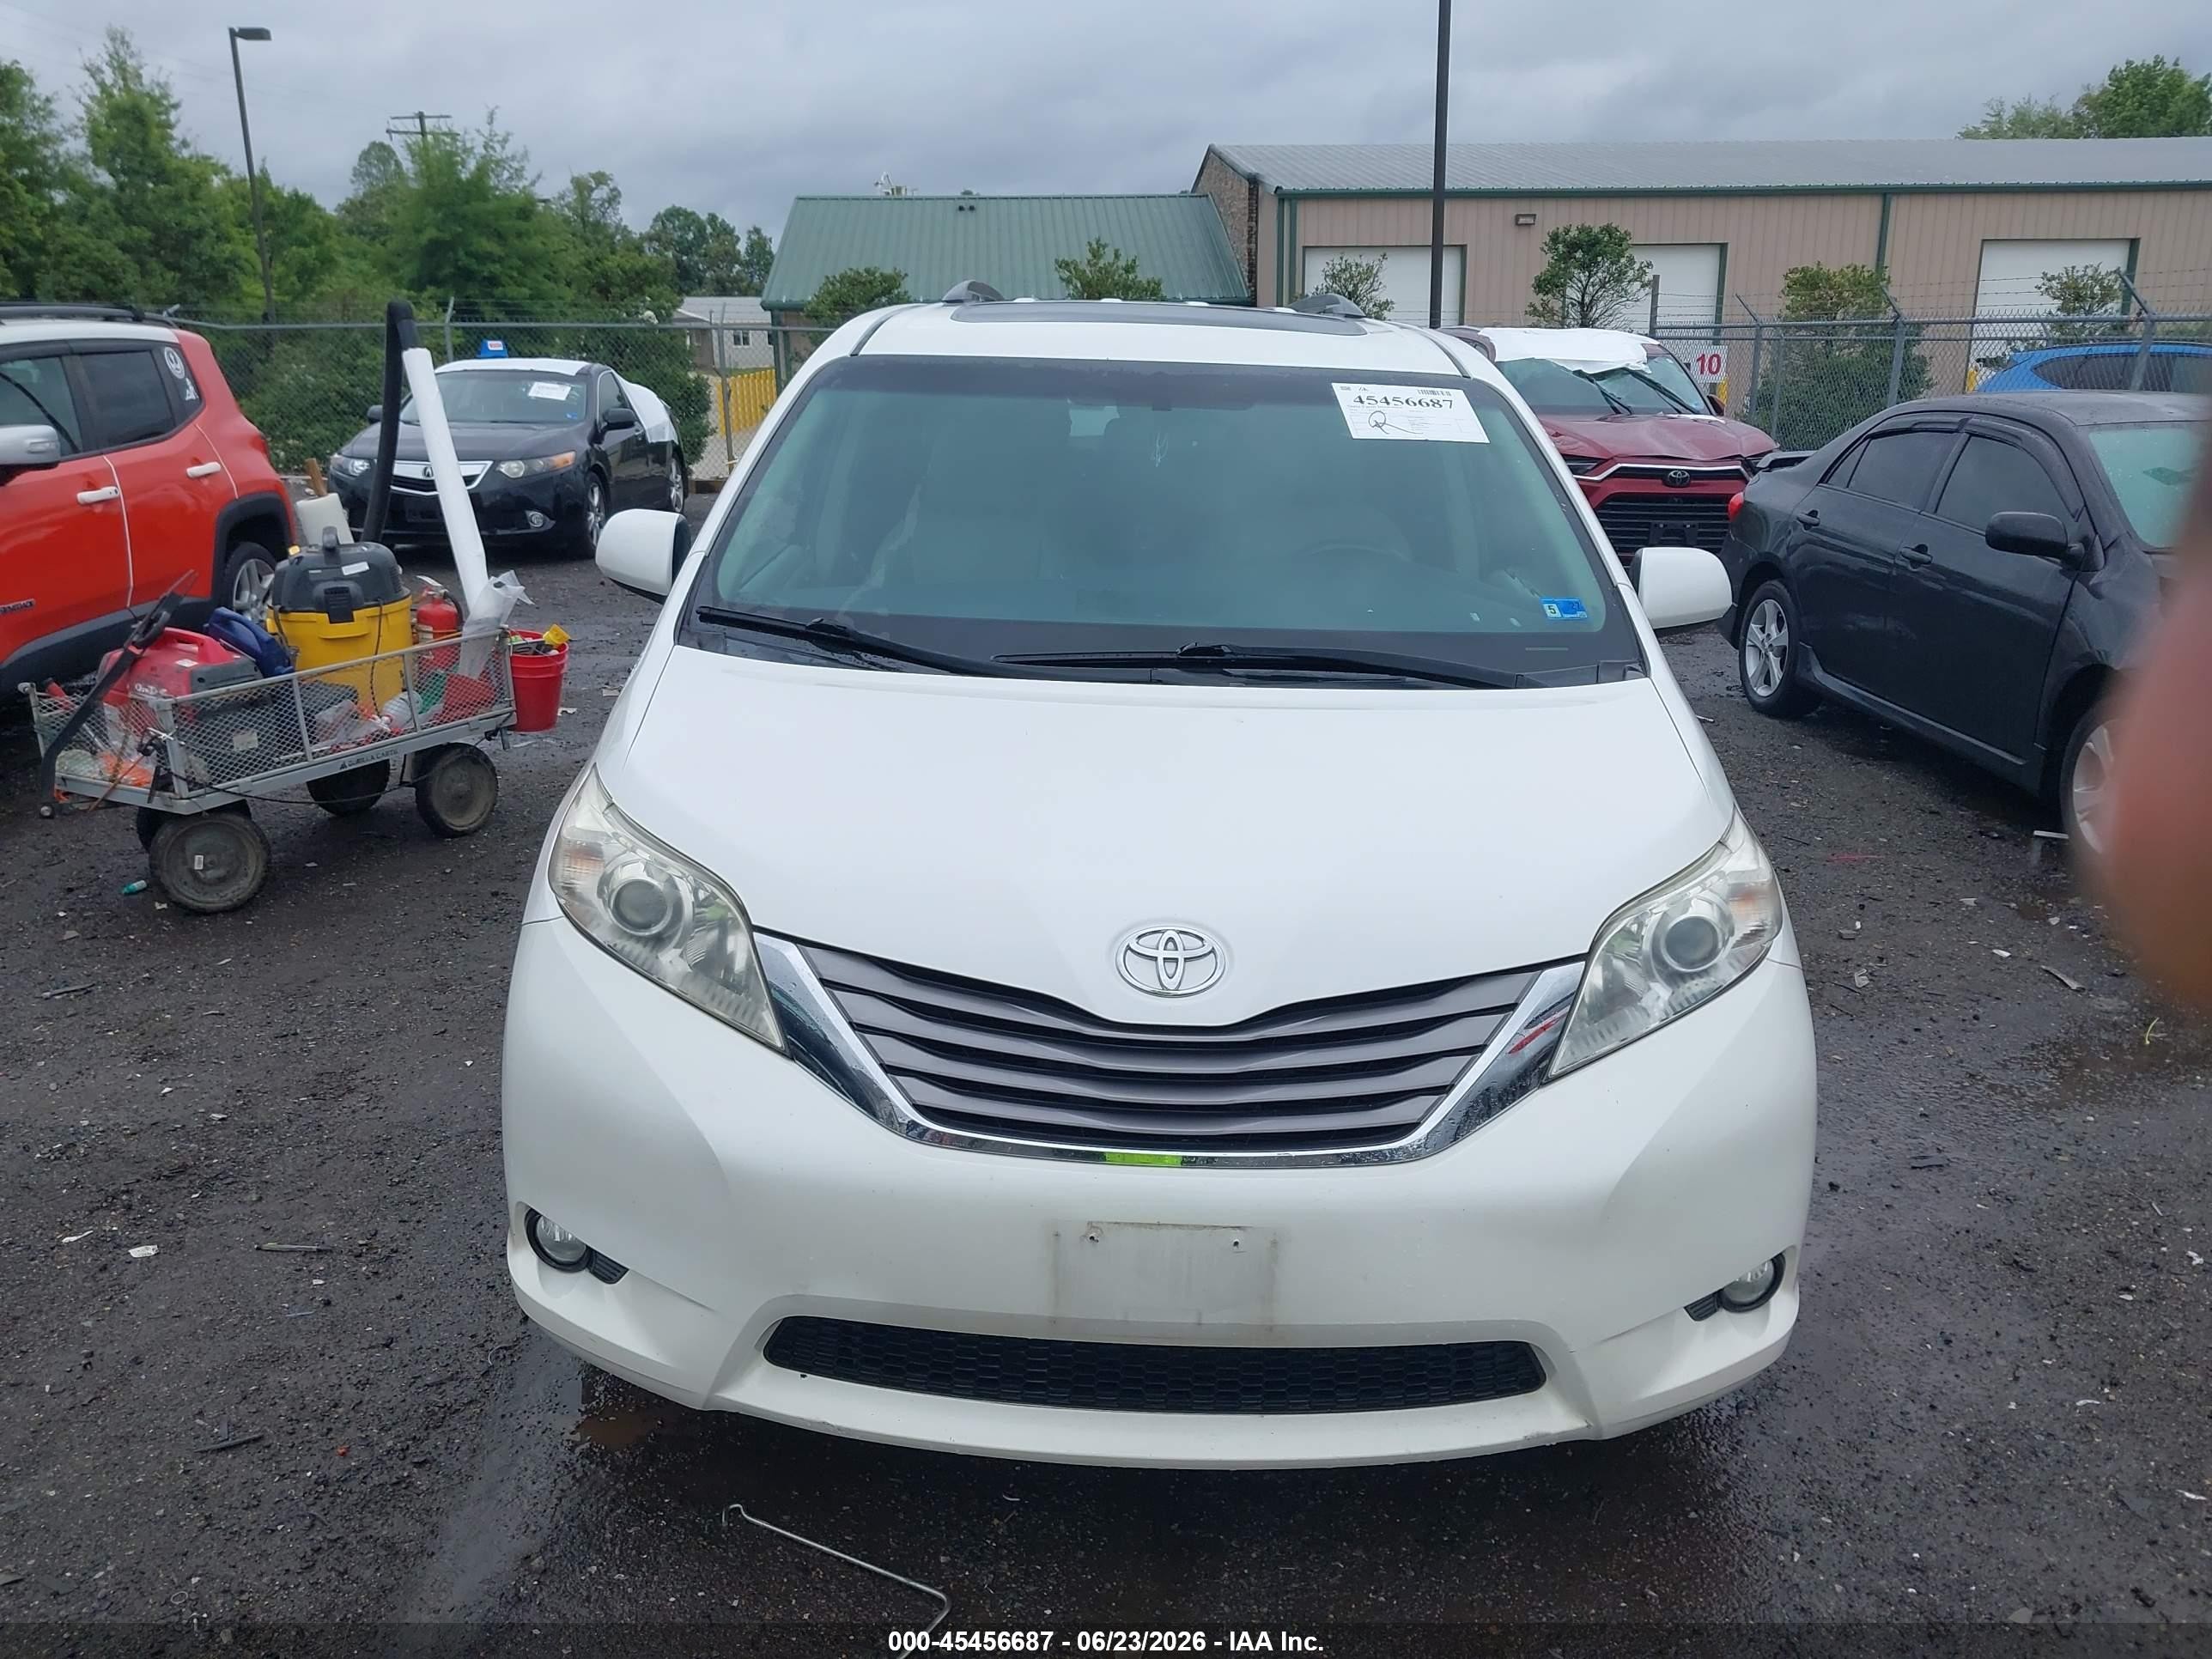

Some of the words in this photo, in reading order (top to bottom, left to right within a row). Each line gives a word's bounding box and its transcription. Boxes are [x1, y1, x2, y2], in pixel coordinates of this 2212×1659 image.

[1697, 354, 1721, 375] 10
[1353, 395, 1453, 409] 45456687
[1548, 605, 1557, 614] 5
